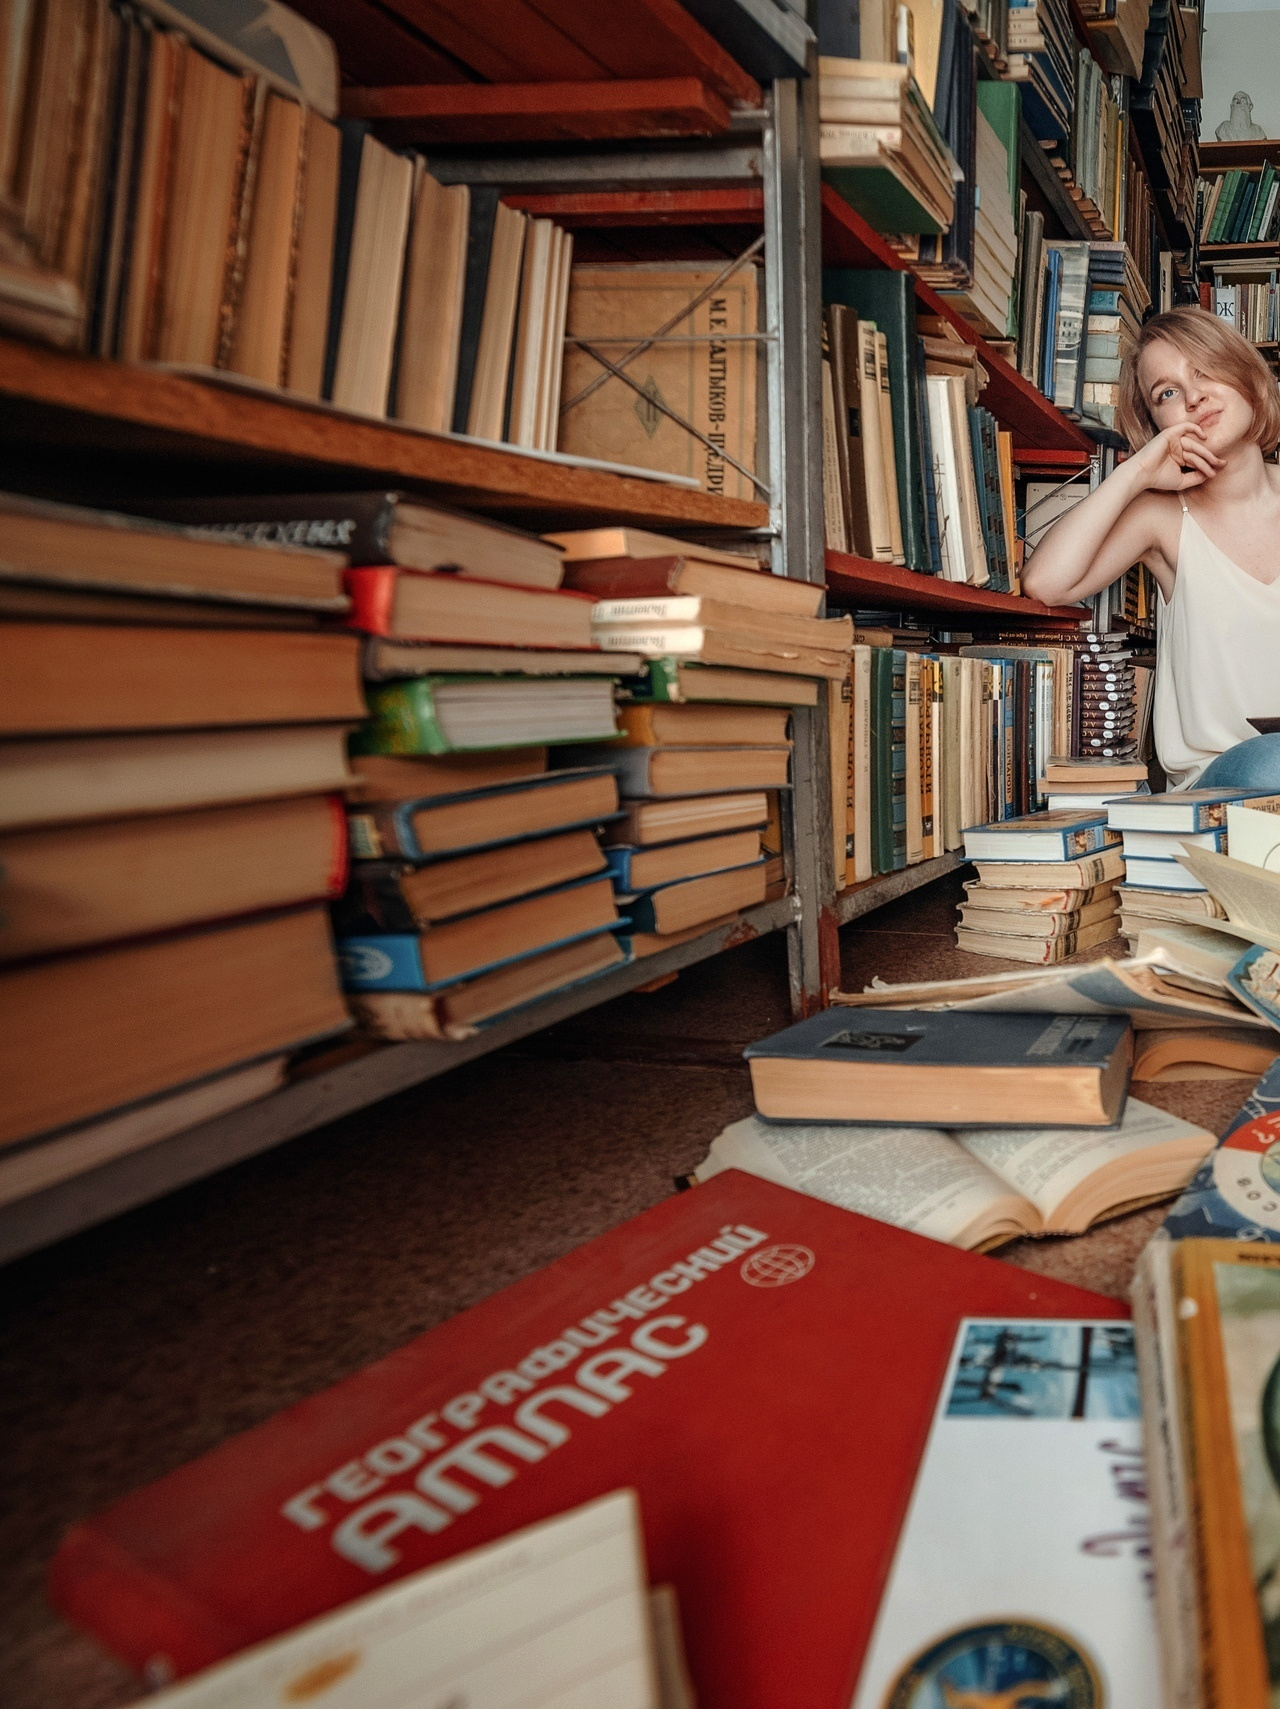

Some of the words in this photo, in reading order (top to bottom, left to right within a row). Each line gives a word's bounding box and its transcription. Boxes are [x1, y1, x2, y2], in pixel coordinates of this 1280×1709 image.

[925, 687, 933, 778] ГОНЧАРОВ
[281, 1223, 770, 1532] ГЕОГРАФИЧЕСКИЙ
[330, 1314, 710, 1574] АТЛАС
